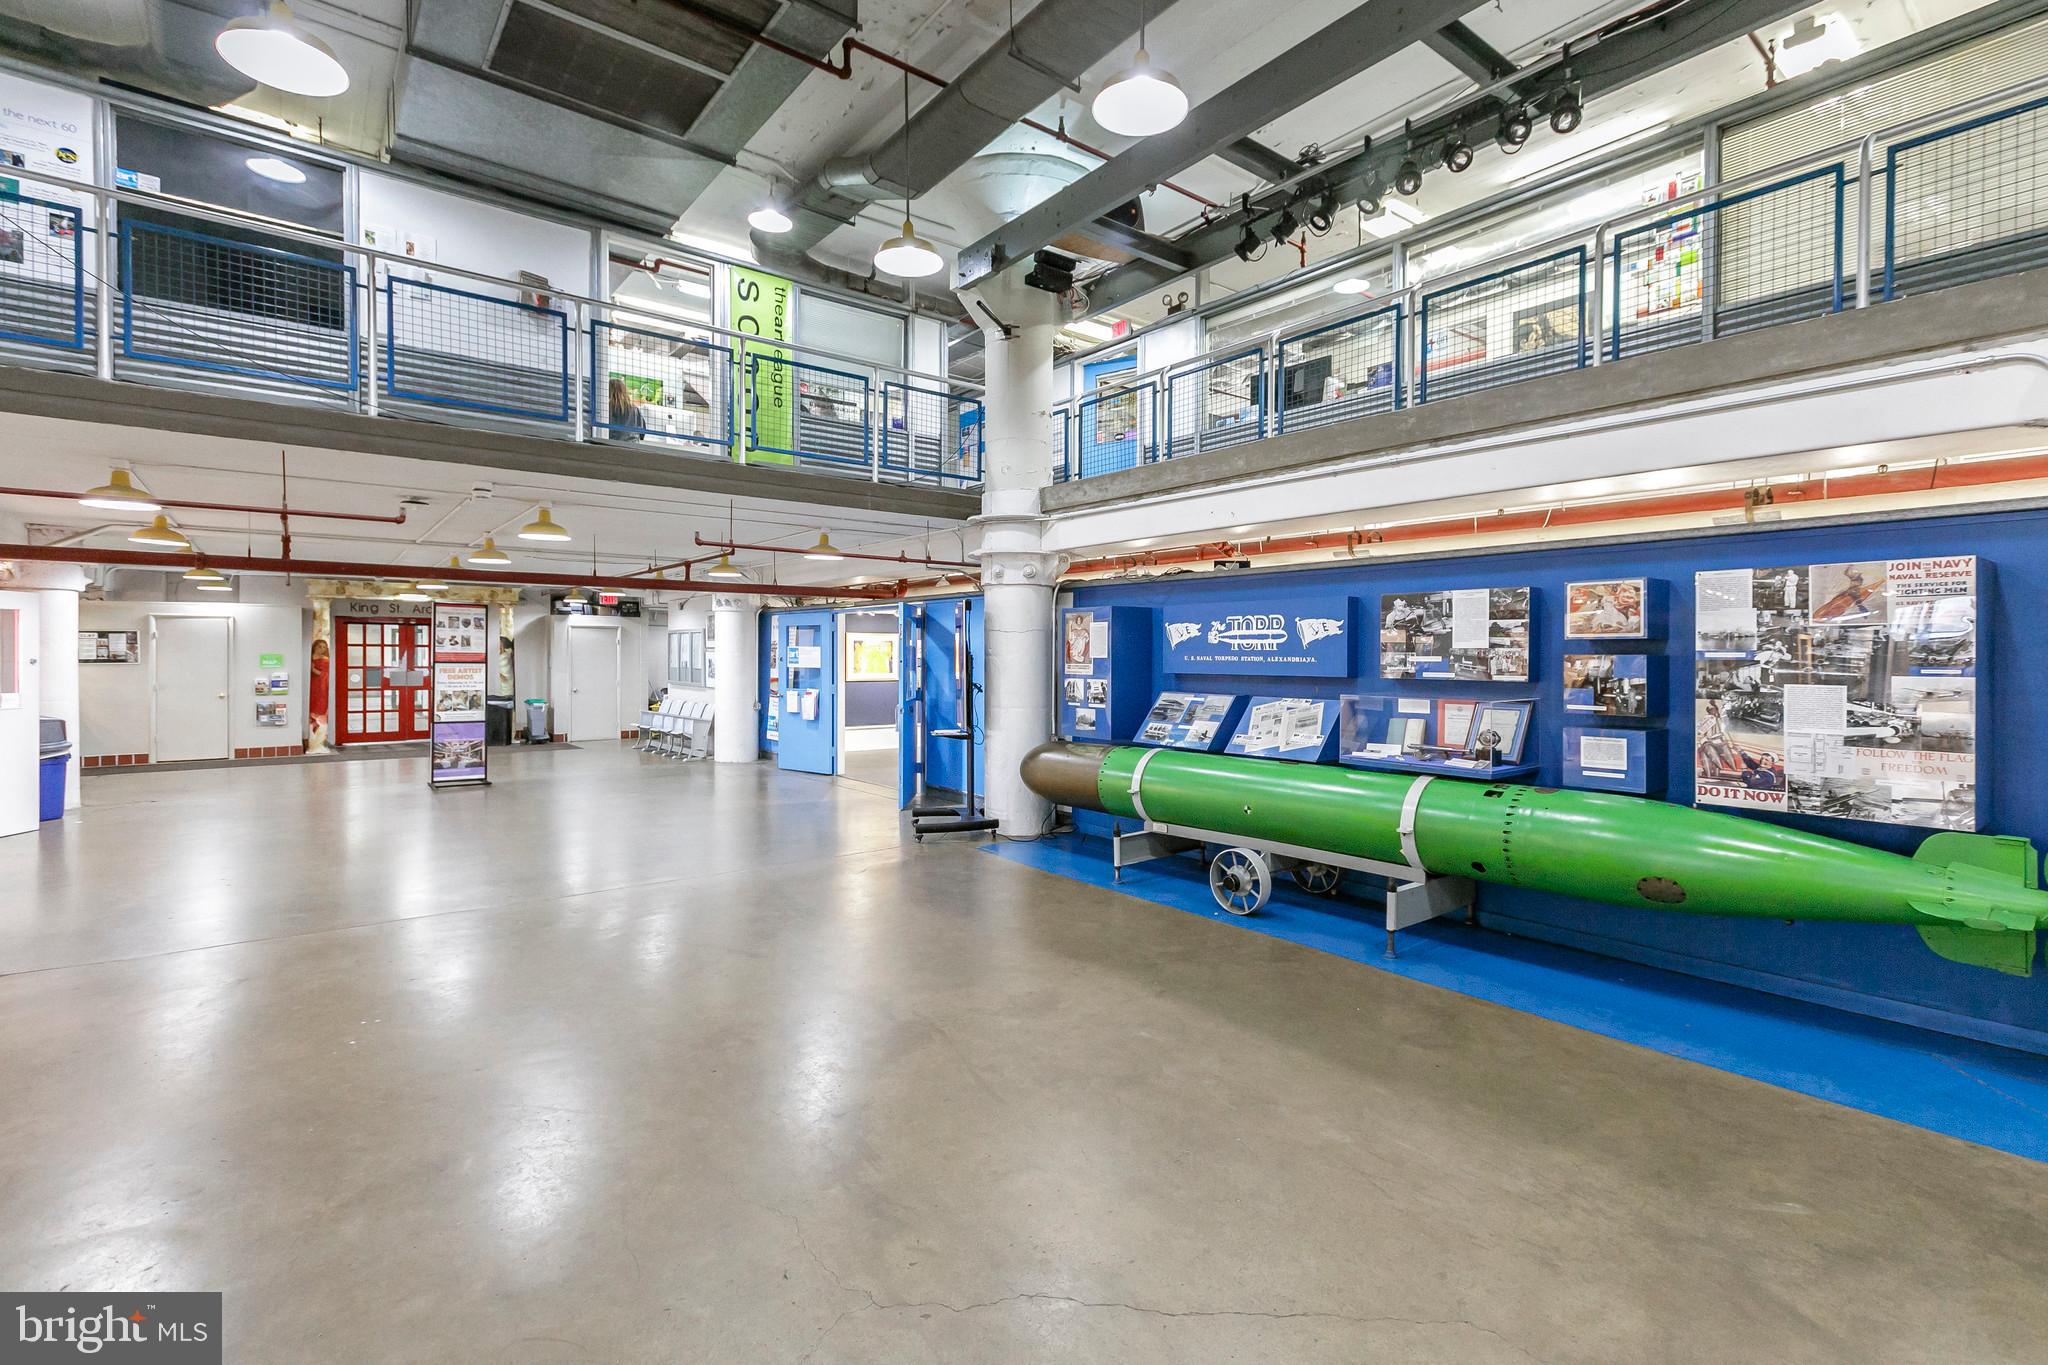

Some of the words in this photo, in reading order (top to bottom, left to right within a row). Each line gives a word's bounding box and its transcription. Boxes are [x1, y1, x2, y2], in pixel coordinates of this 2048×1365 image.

[3, 108, 24, 120] the
[28, 115, 57, 129] next
[60, 122, 78, 133] 60
[1889, 561, 1921, 572] JOIN
[1932, 558, 1973, 569] NAVY
[1889, 573, 1922, 581] NAVAL
[1925, 570, 1973, 579] RESERVE
[350, 602, 379, 614] King
[1855, 748, 1908, 759] FOLLOW
[1913, 751, 1935, 761] THE
[1940, 752, 1974, 763] FLAG
[1881, 762, 1948, 775] FREEDOM
[1697, 785, 1721, 797] DO
[1723, 787, 1740, 799] IT
[1743, 789, 1786, 804] NOW
